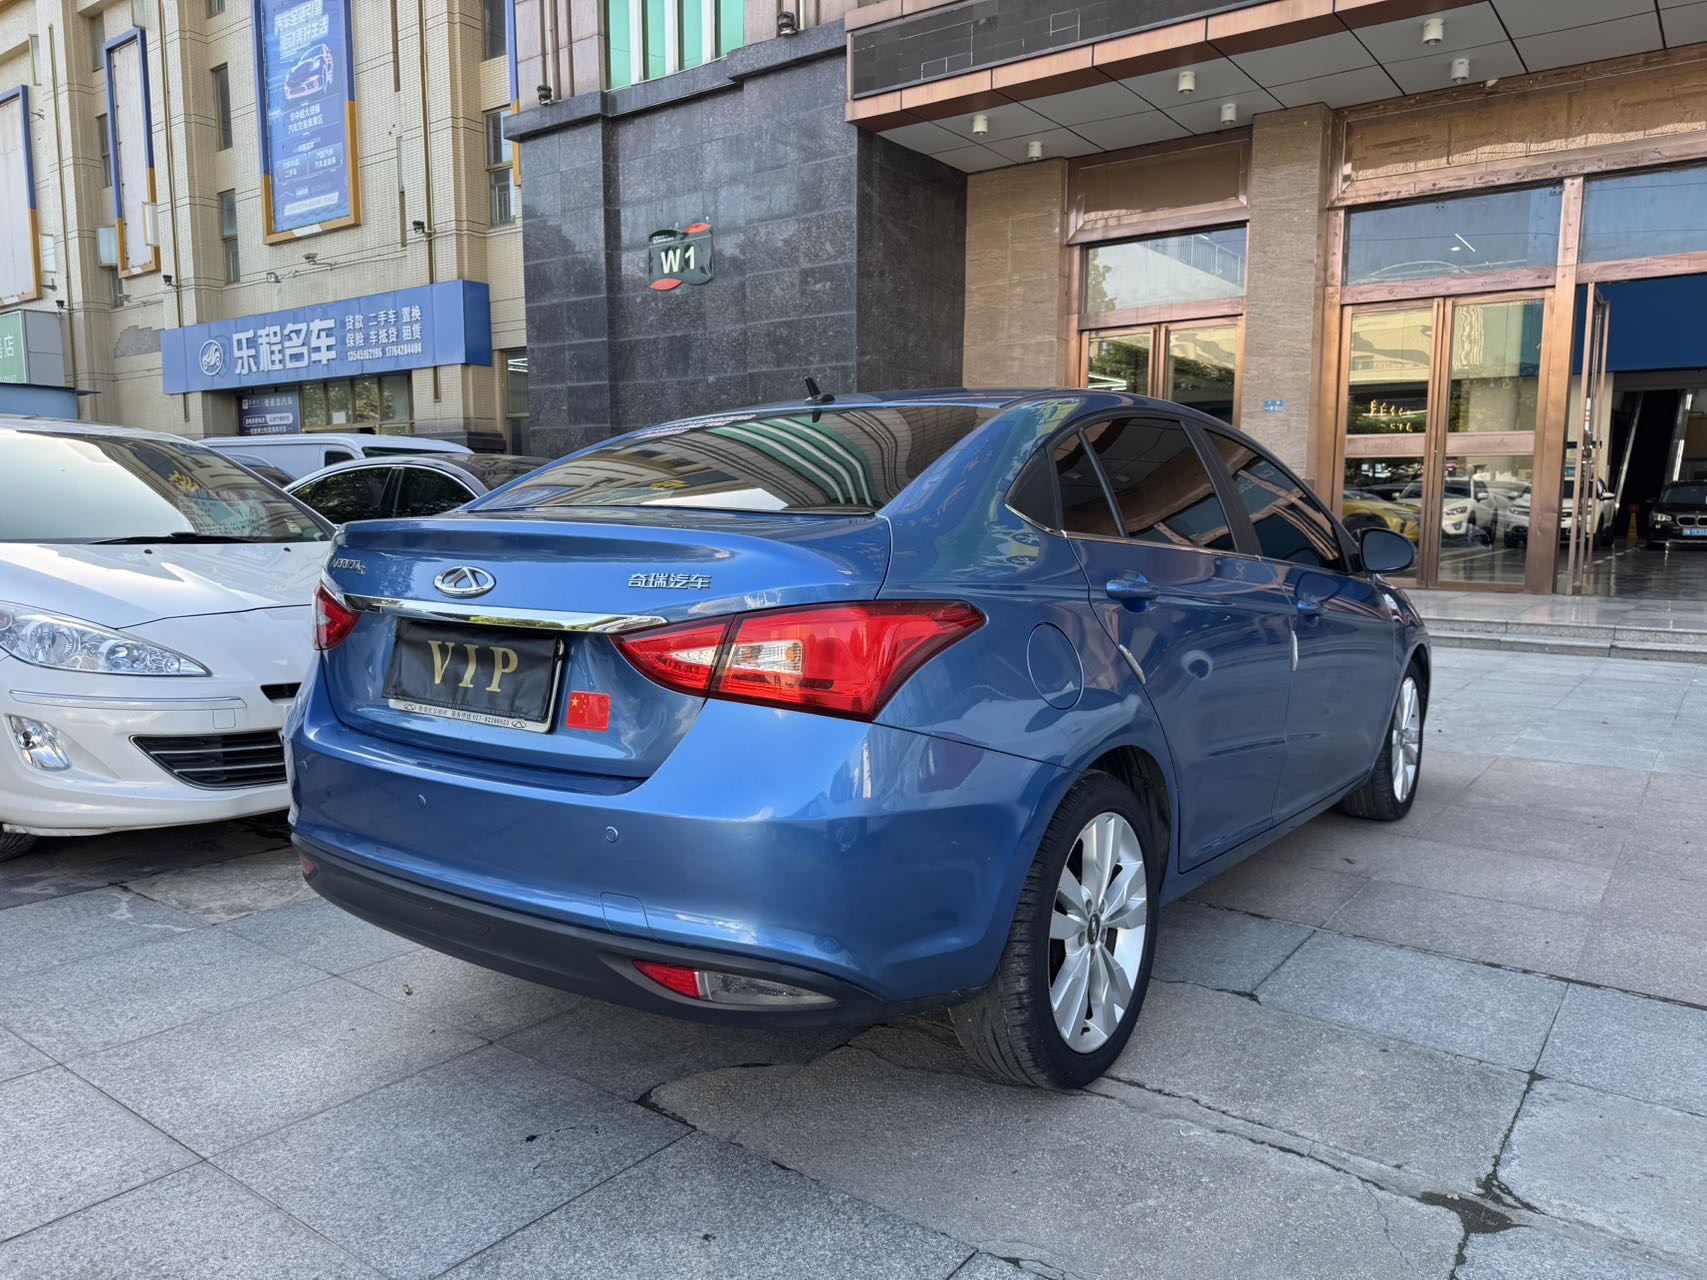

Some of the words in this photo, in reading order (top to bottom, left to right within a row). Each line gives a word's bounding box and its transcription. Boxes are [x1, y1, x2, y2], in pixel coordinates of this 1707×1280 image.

[660, 246, 695, 274] W1
[345, 313, 363, 331] 贷款
[368, 309, 397, 326] 二手车
[402, 304, 421, 322] 置换
[232, 318, 337, 375] 乐程名车
[346, 331, 365, 348] 保险
[402, 323, 422, 341] 租赁
[628, 572, 712, 589] 奇瑞汽车
[427, 640, 519, 692] VIP
